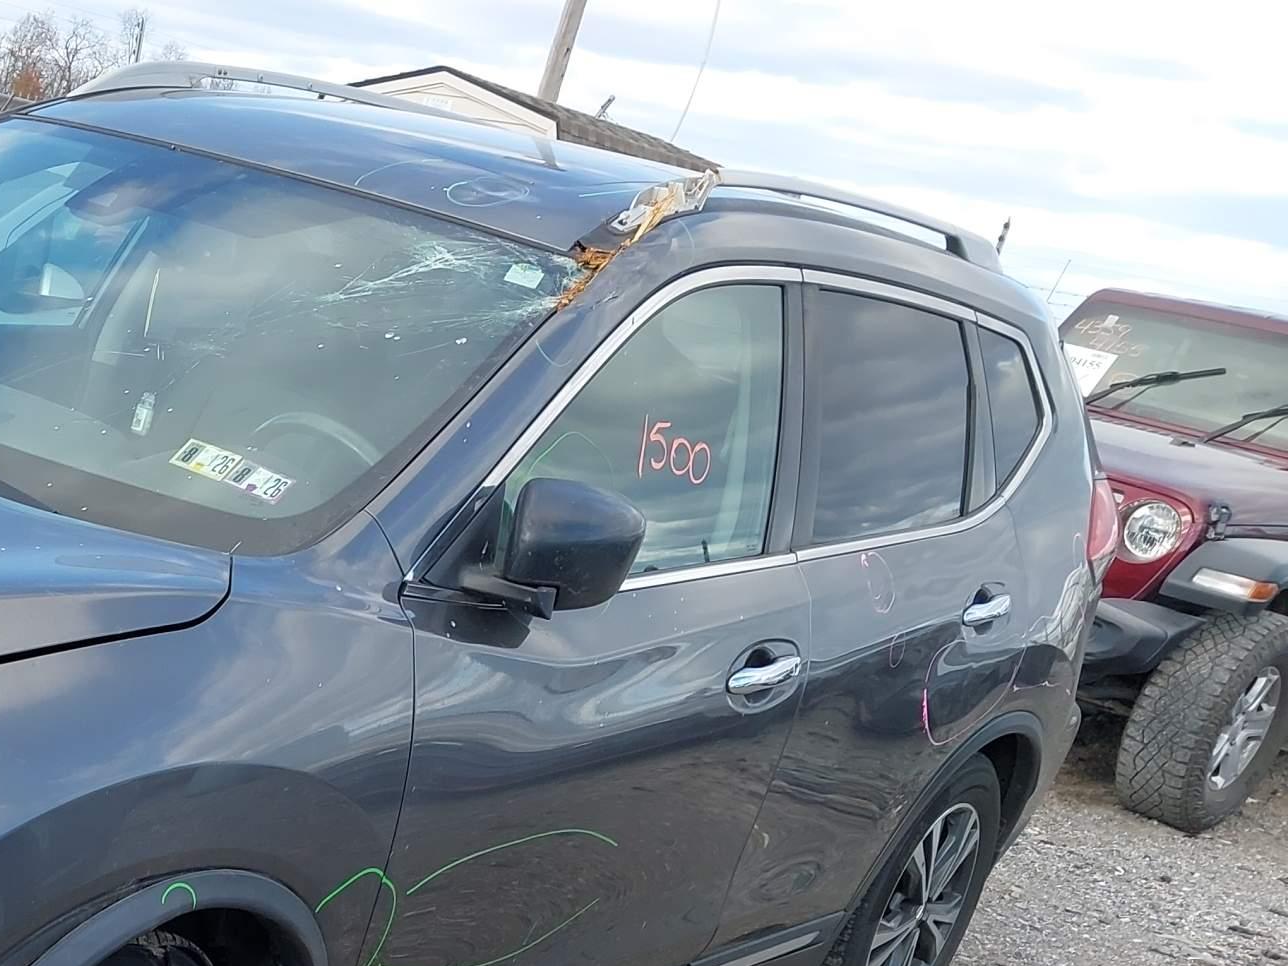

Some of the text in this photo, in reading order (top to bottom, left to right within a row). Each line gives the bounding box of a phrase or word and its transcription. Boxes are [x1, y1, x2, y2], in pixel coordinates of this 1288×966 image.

[638, 413, 711, 486] 1500
[211, 455, 236, 475] 26
[263, 478, 289, 498] 26
